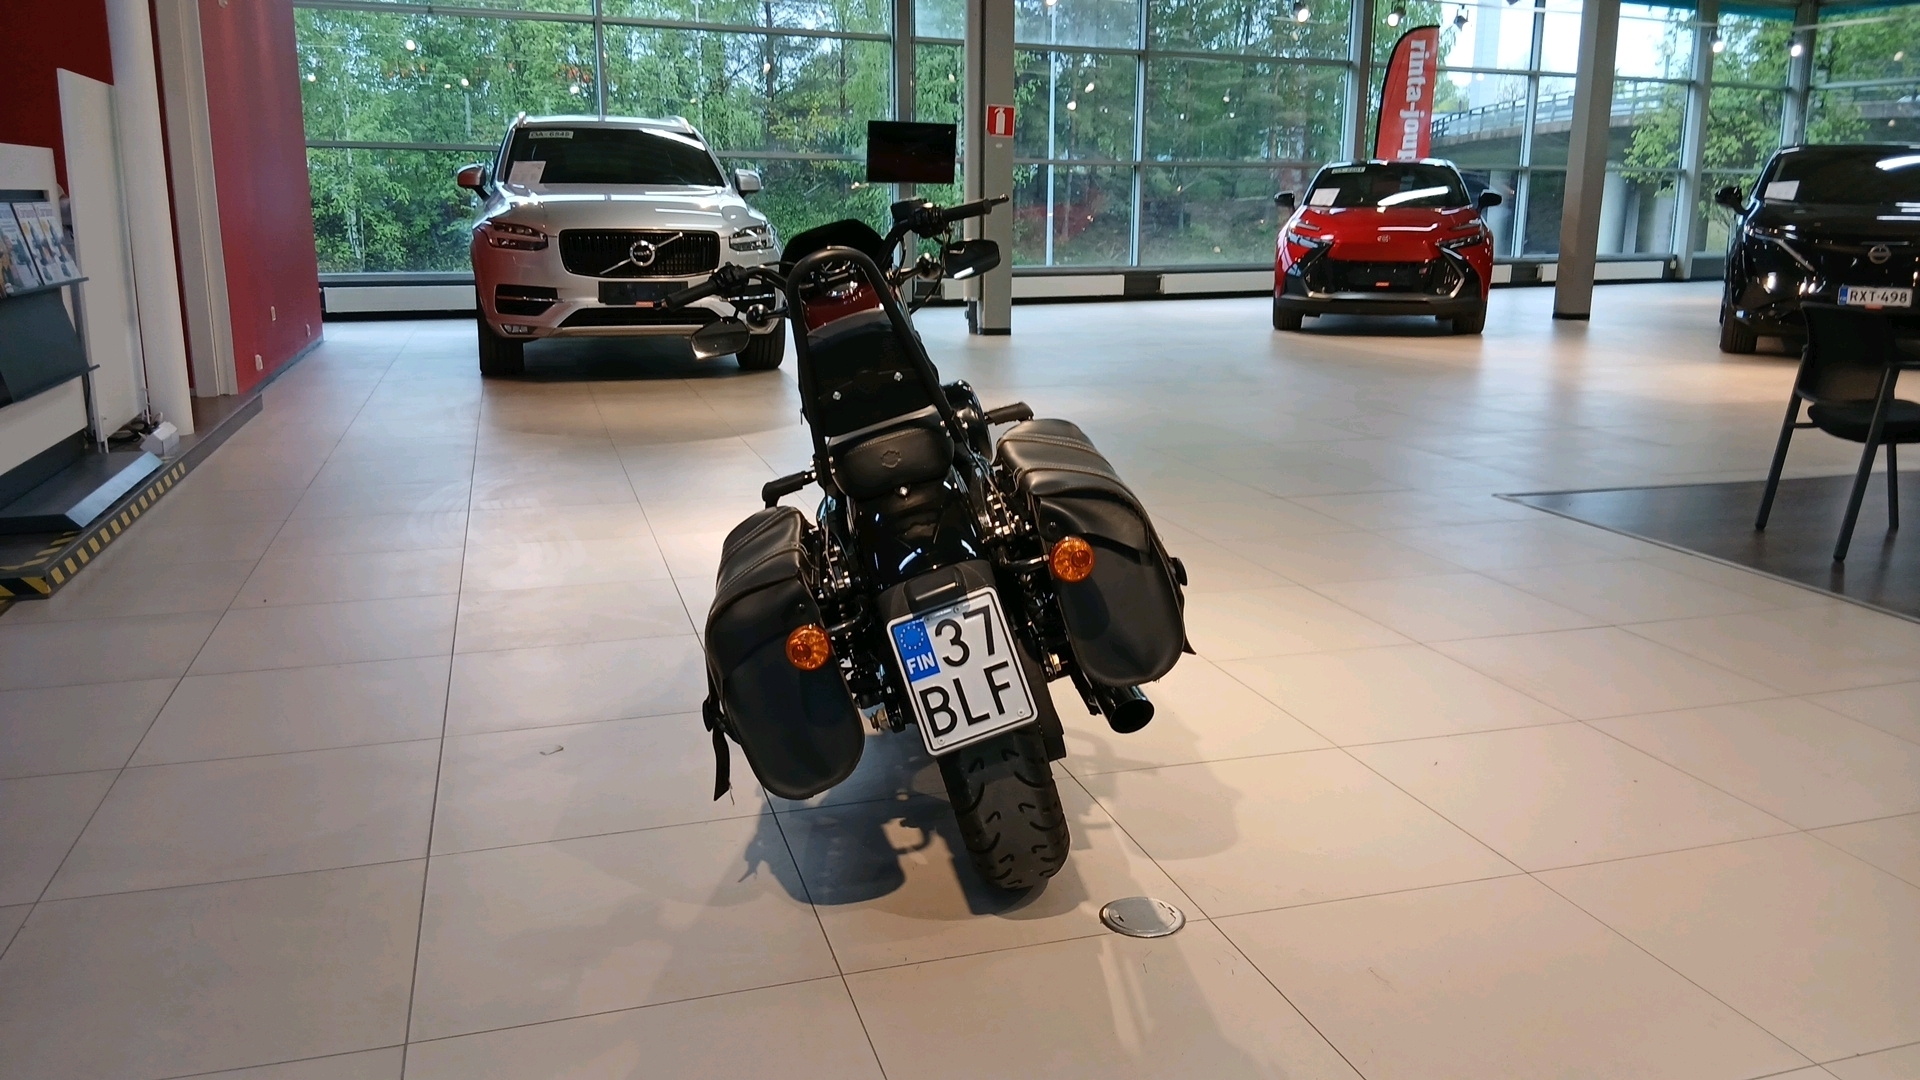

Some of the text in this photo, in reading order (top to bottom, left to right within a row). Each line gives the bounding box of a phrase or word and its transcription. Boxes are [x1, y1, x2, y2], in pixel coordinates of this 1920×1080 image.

[1849, 290, 1908, 304] RXT-498
[934, 604, 996, 668] 37
[906, 651, 936, 675] FIN
[918, 660, 1011, 739] BLF
